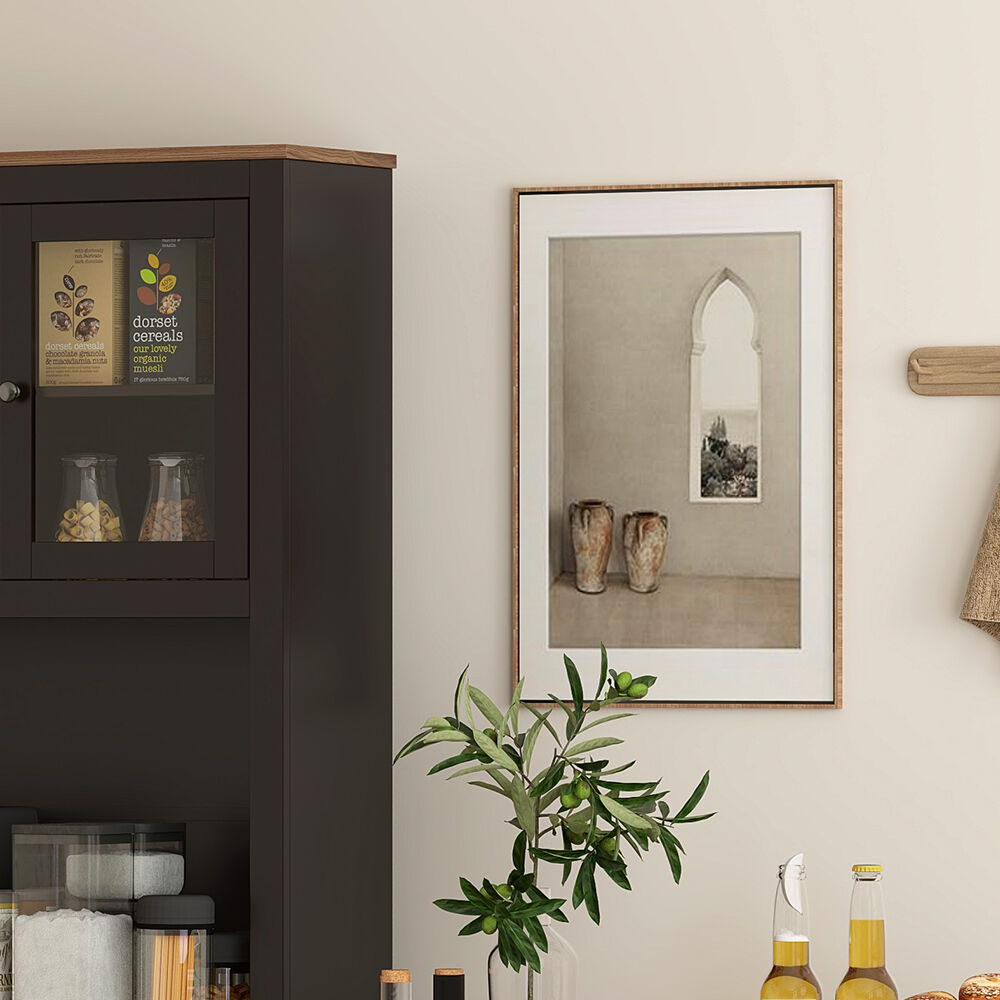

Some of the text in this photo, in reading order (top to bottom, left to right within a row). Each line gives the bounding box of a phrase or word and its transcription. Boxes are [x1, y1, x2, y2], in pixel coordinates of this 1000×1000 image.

[132, 315, 178, 328] dorset
[132, 329, 184, 342] cereals
[45, 342, 105, 350] dorset cereals
[133, 344, 177, 355] our lovely
[79, 350, 106, 358] granola
[133, 354, 167, 365] organic
[133, 363, 164, 373] muesli
